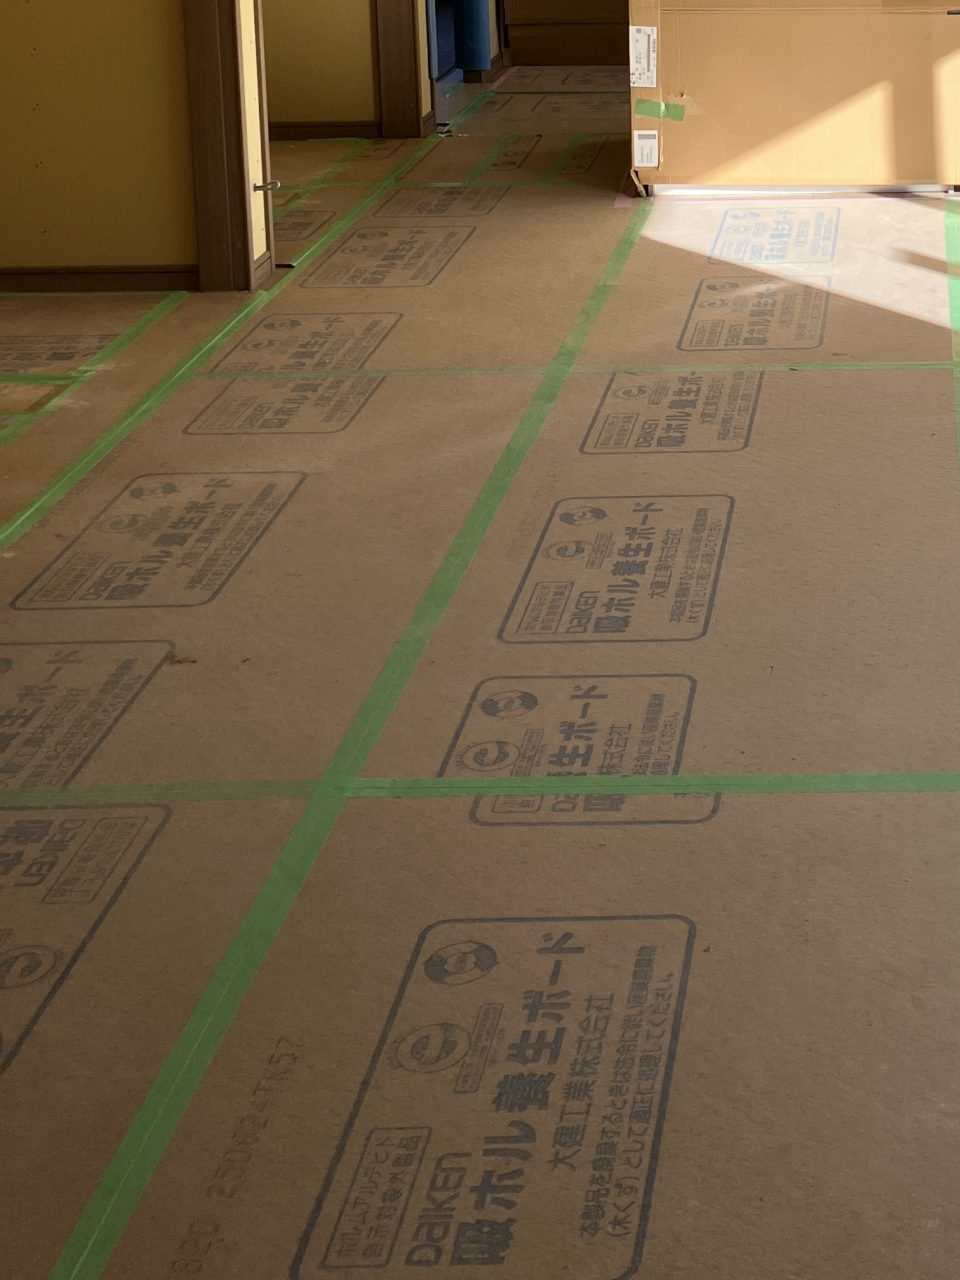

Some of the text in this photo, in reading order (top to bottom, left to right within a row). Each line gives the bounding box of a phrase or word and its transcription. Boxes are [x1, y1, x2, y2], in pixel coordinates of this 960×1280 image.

[588, 501, 667, 634] 吸ホル養生ボード
[442, 931, 593, 1265] 吸ホル養生ボード
[541, 994, 616, 1171] 大建工業株式会社
